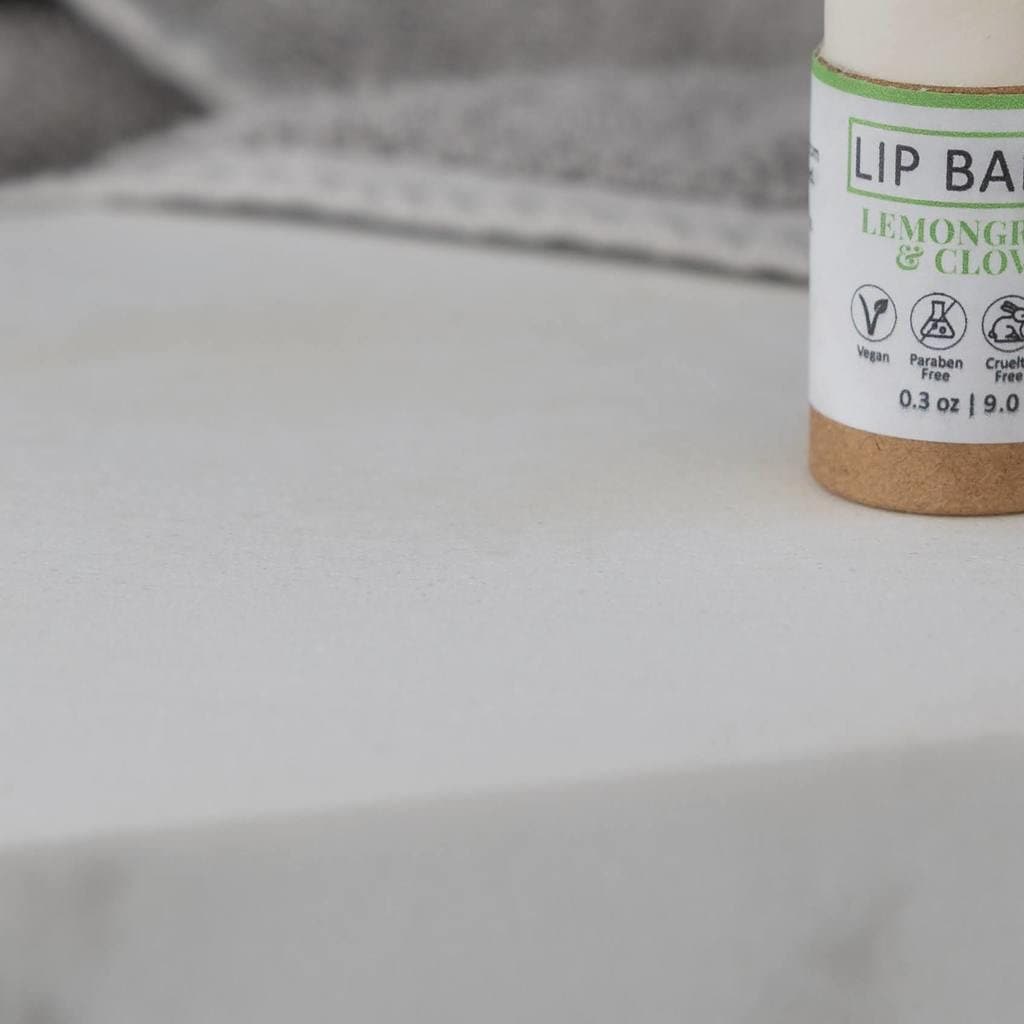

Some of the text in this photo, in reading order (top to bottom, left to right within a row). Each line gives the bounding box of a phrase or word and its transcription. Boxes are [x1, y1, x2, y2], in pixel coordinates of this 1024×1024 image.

[855, 136, 920, 186] LIP
[896, 245, 924, 271] &
[857, 345, 890, 363] Vegan
[909, 354, 963, 370] Paraben
[921, 368, 951, 382] Free
[995, 369, 1023, 383] Free
[899, 389, 930, 410] 0.3
[936, 398, 960, 413] oz
[983, 394, 1019, 414] 9.0
